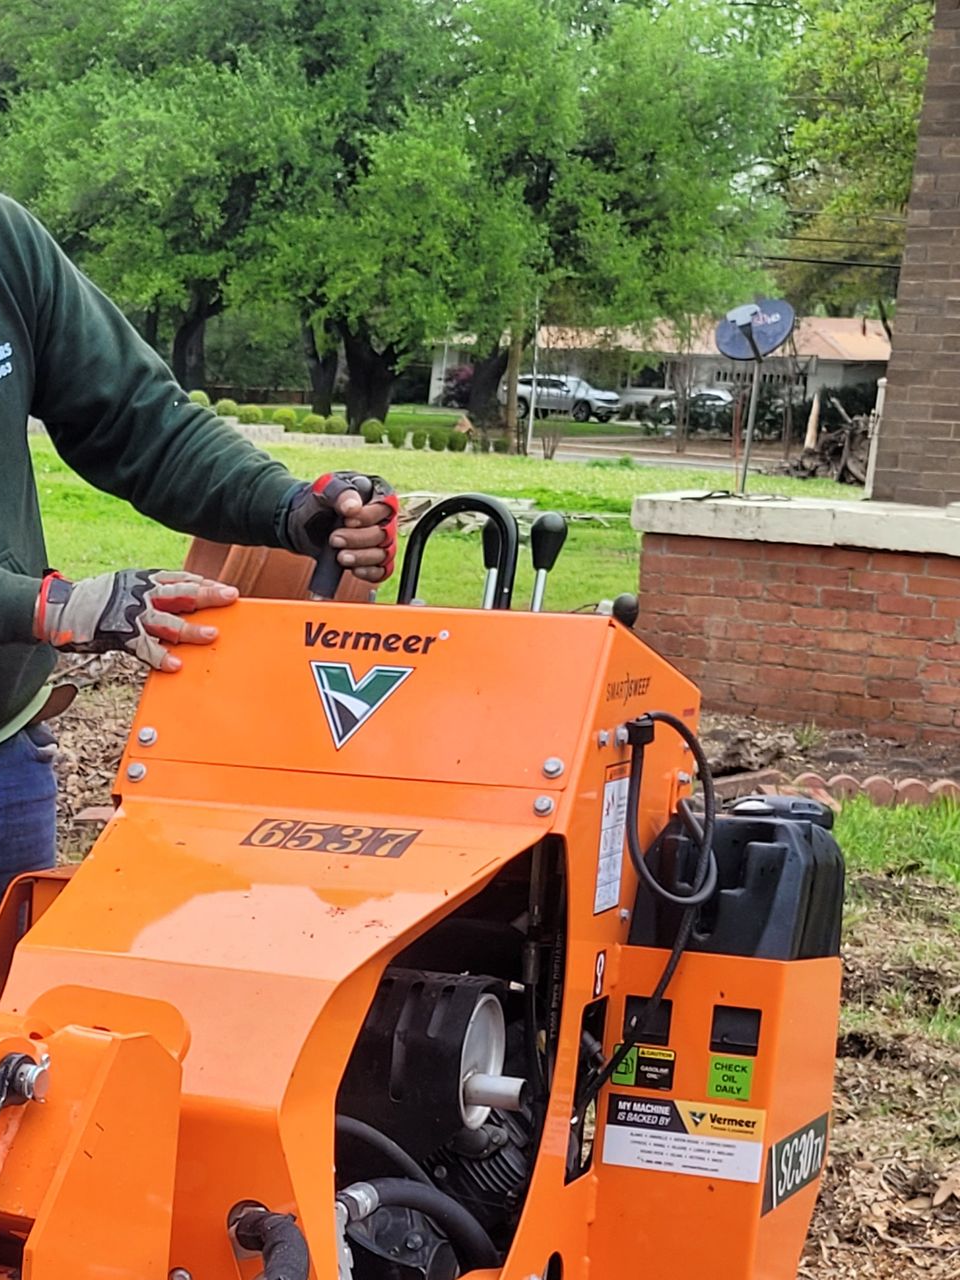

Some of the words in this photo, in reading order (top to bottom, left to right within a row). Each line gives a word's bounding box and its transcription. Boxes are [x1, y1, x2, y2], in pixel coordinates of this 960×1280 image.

[304, 622, 437, 655] Vermeer
[249, 819, 419, 858] 6537
[714, 1062, 748, 1074] CHECK
[721, 1074, 737, 1083] OIL
[715, 1084, 742, 1095] DAILY
[618, 1101, 631, 1111] MY
[632, 1103, 671, 1116] MACHINE
[617, 1111, 626, 1121] IS
[626, 1113, 659, 1125] BACKED
[658, 1116, 671, 1126] BY
[709, 1113, 757, 1129] Vermeer
